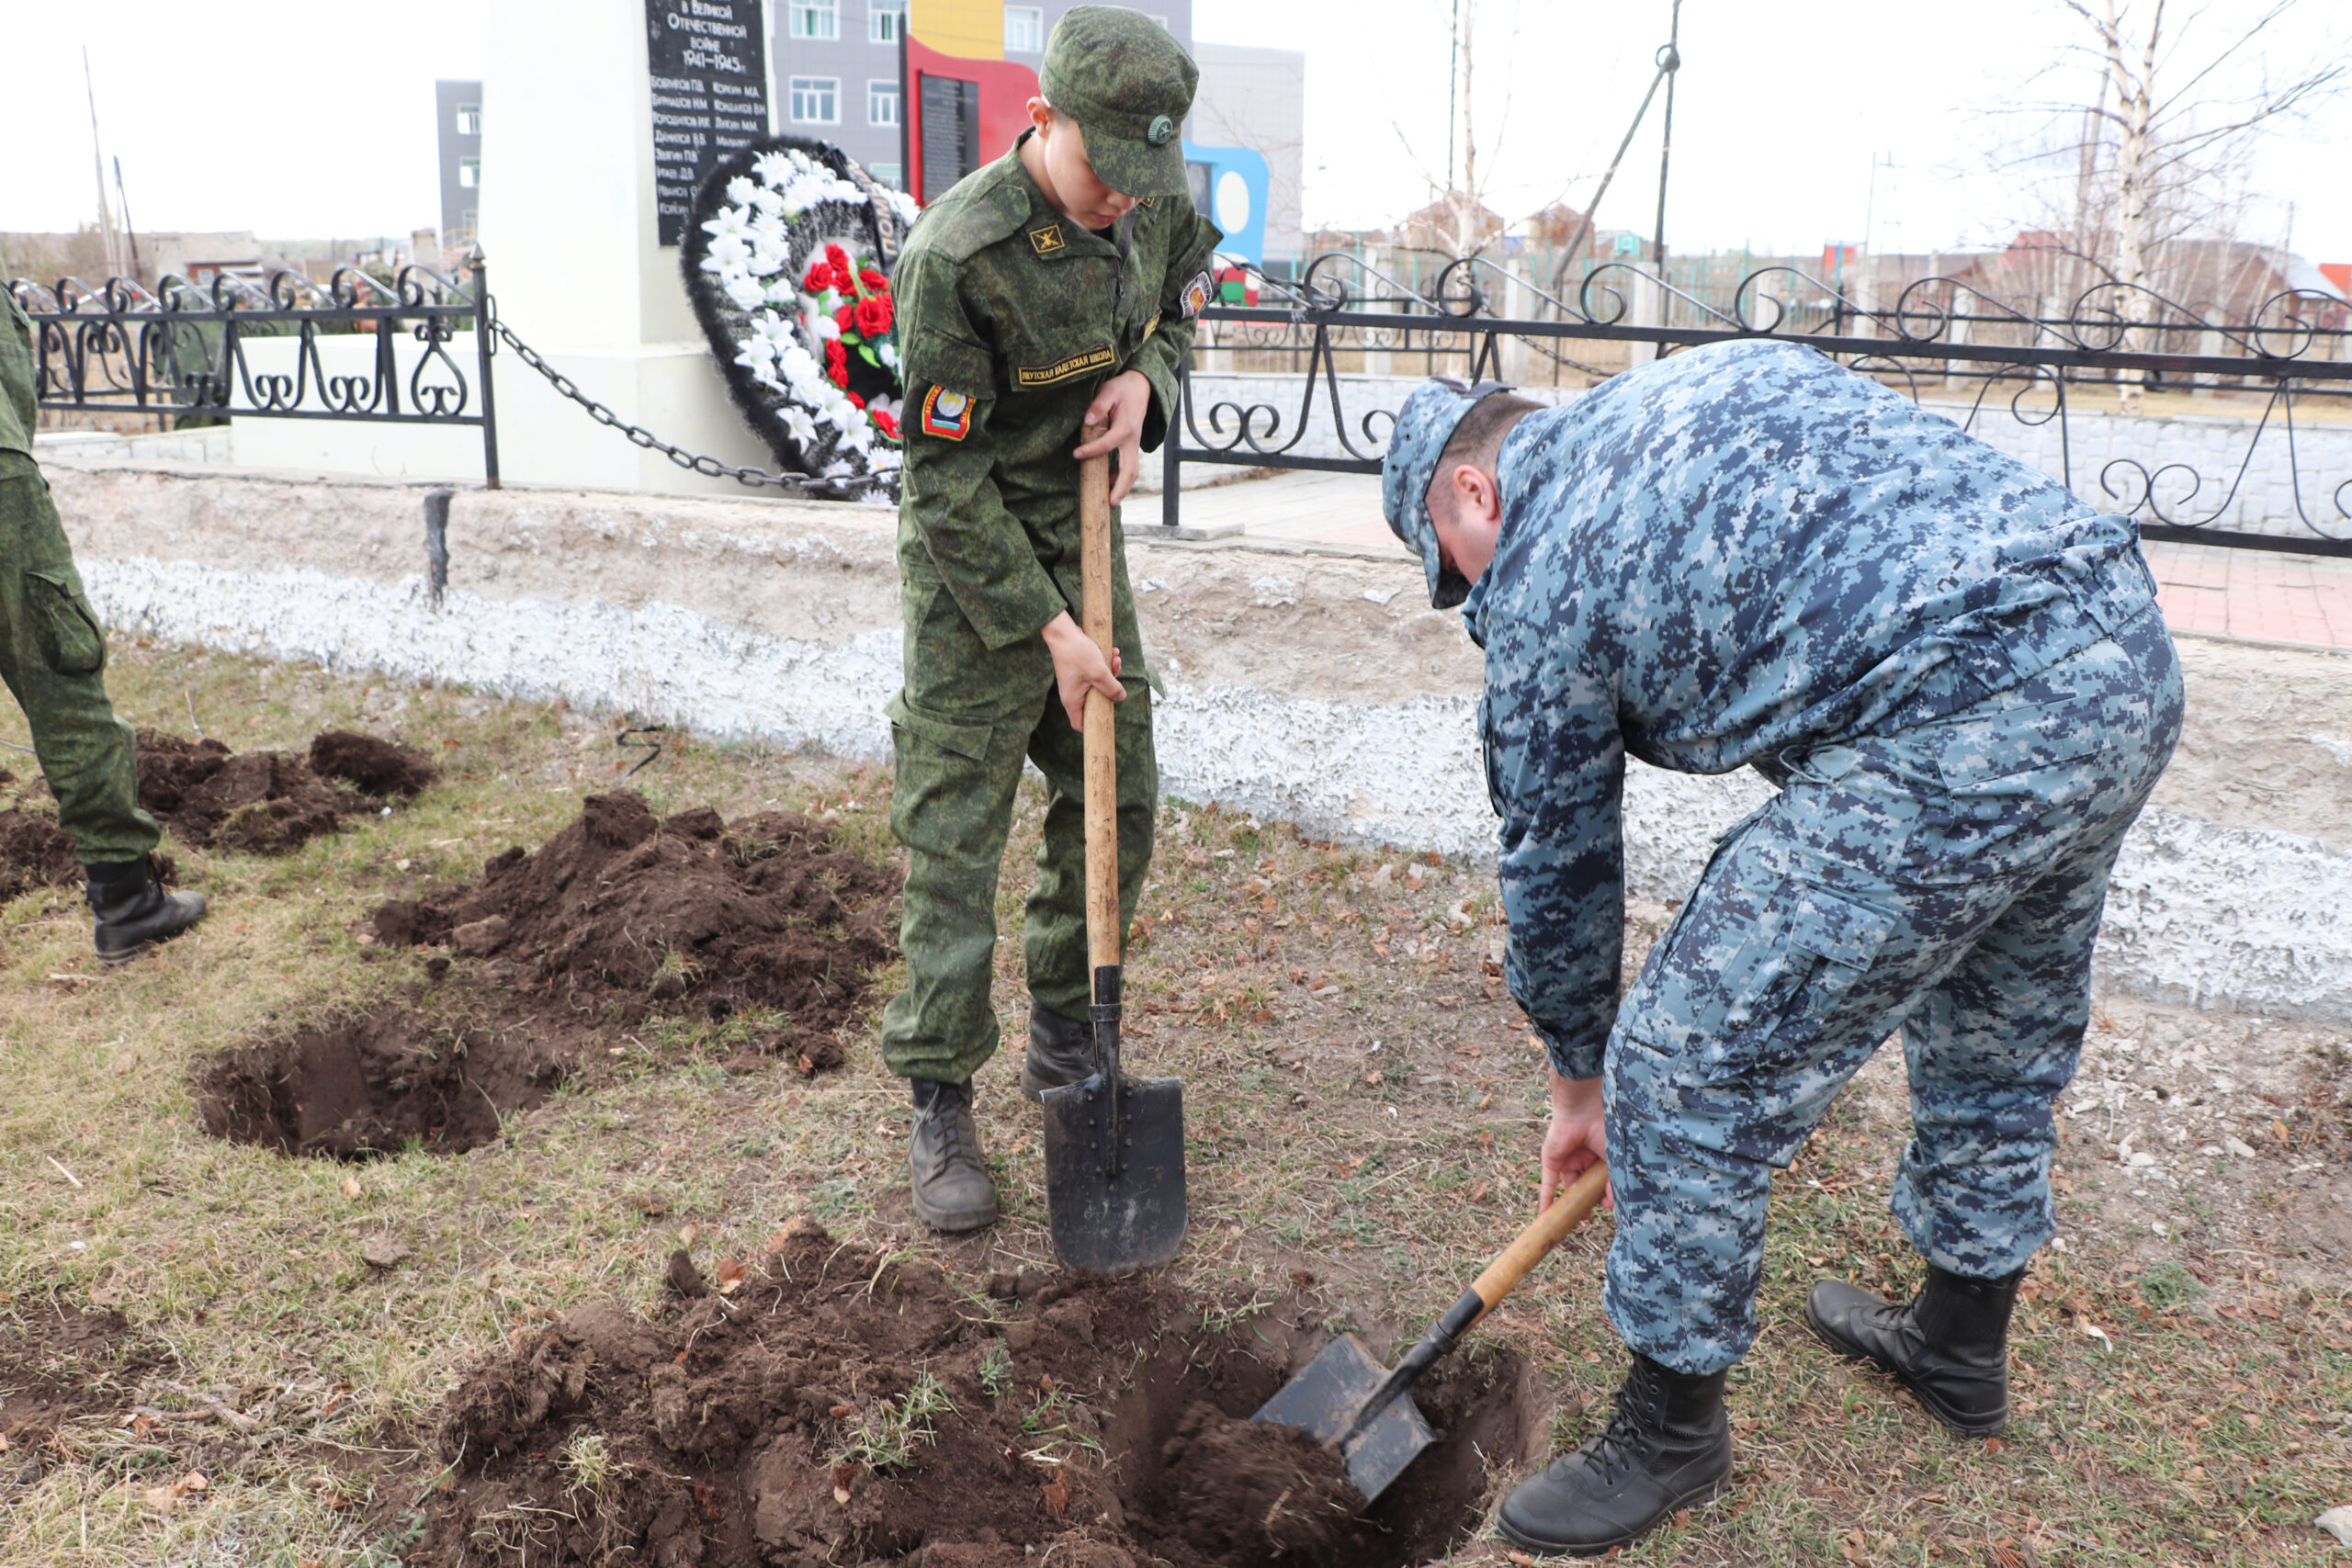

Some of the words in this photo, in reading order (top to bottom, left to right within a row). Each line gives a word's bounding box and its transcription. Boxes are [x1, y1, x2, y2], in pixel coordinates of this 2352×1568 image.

[690, 37, 720, 52] ВОЙНЕ
[1021, 368, 1055, 381] ЯКУТСКАЯ
[1054, 355, 1090, 377] КАДЕТСКАЯ
[1089, 350, 1112, 364] ШКОЛА
